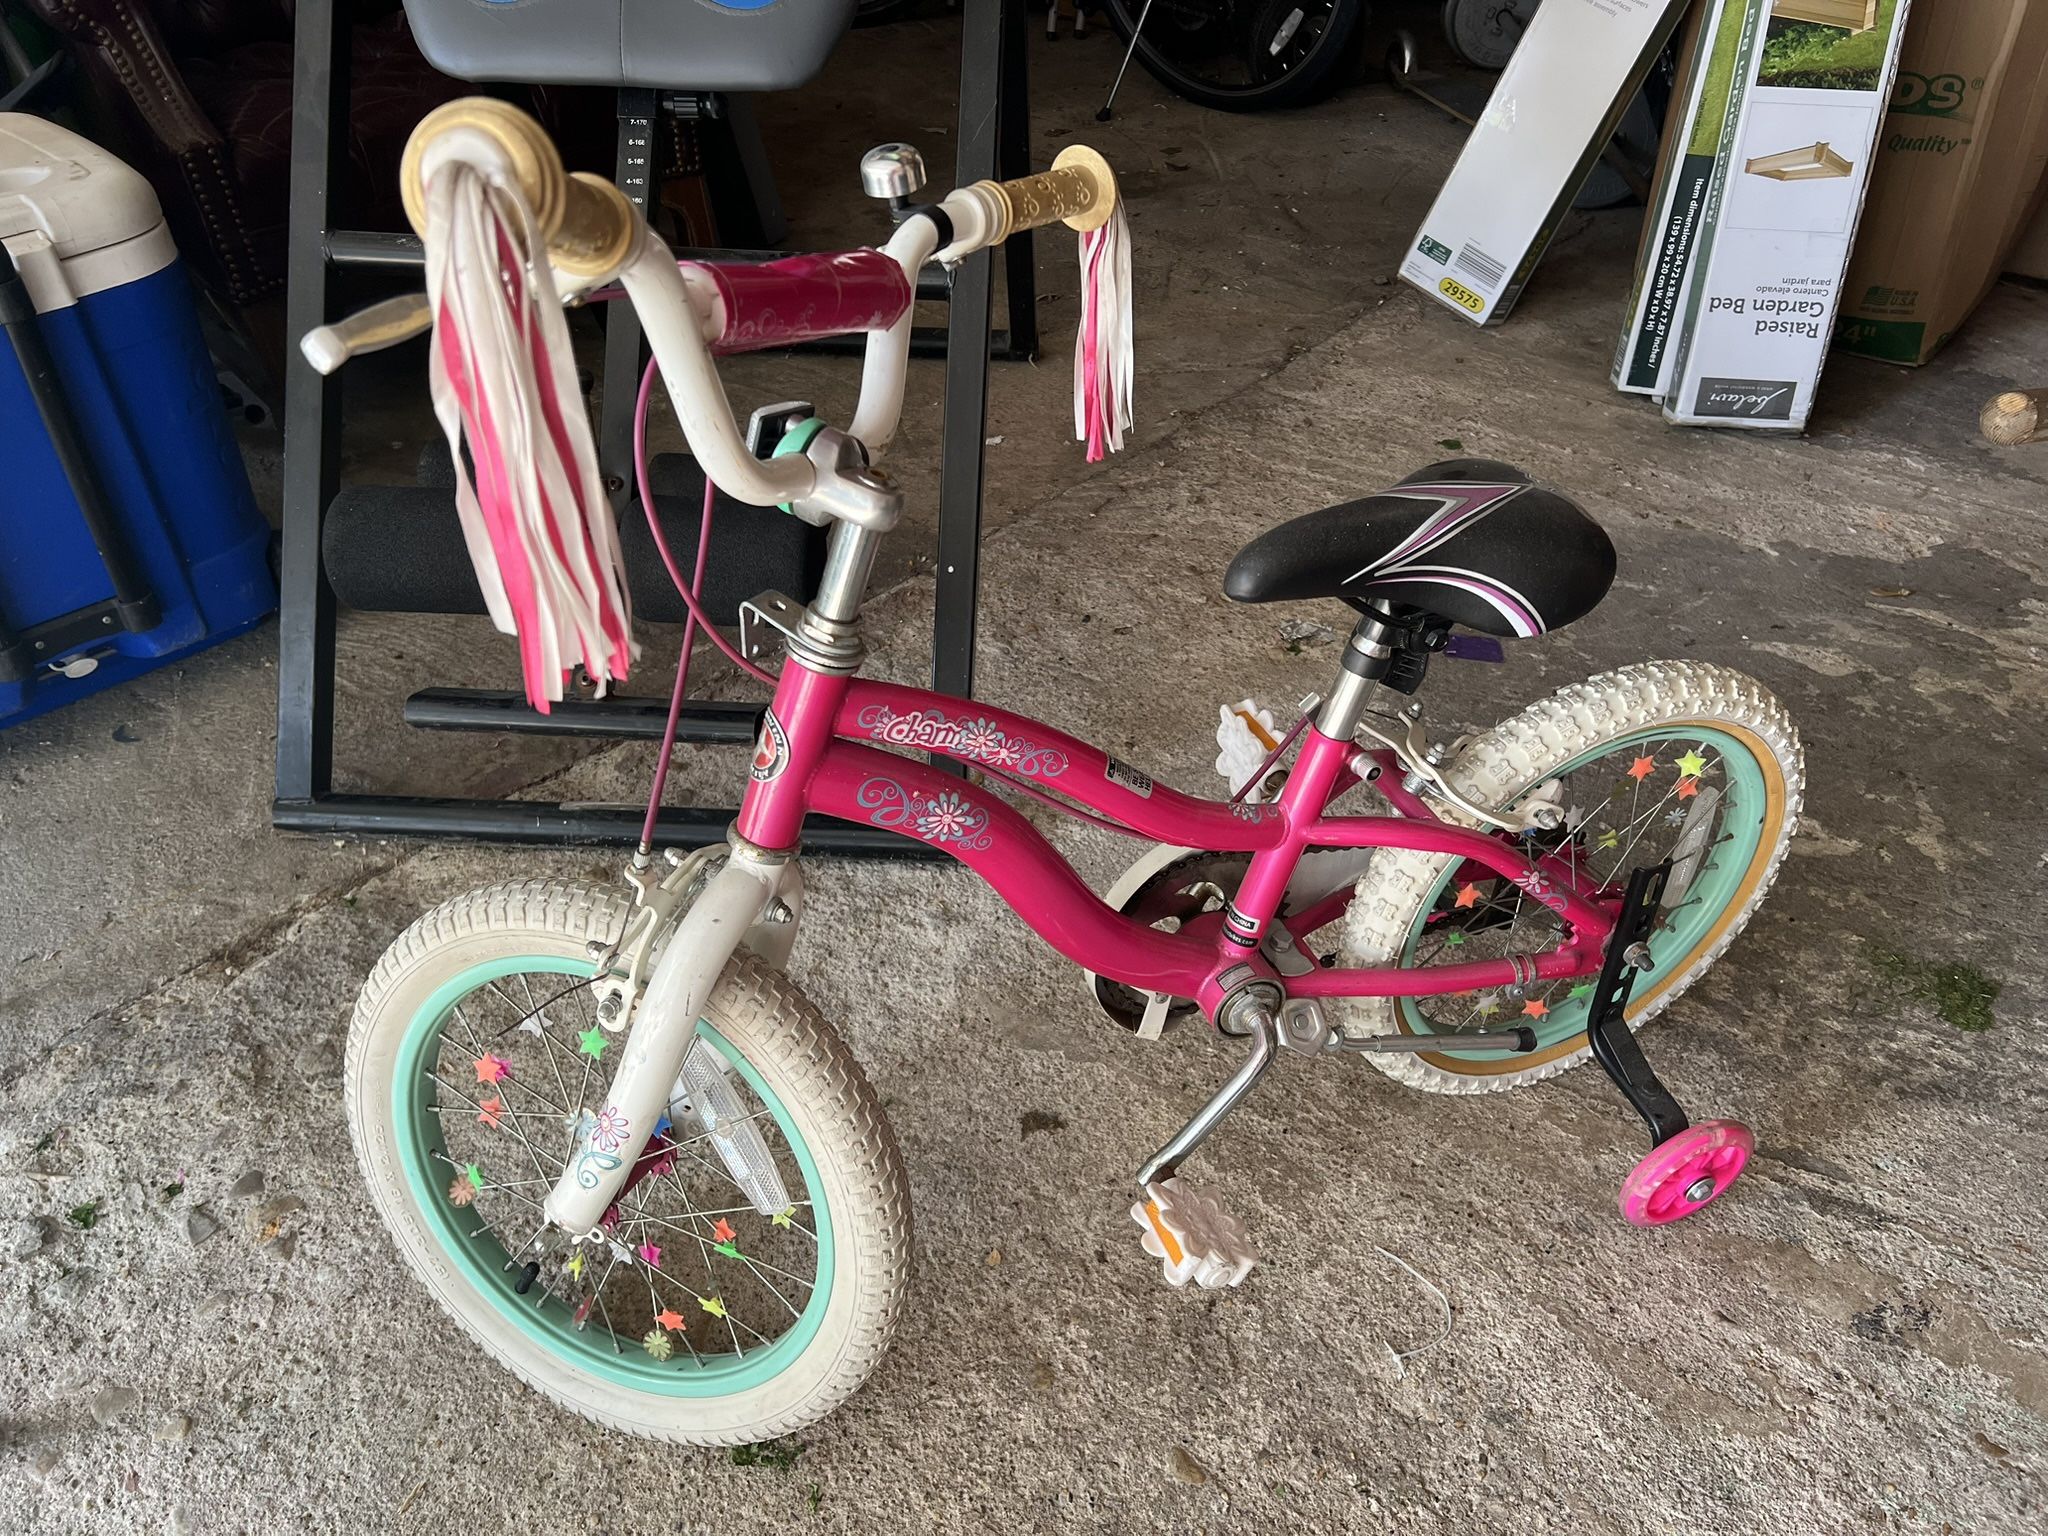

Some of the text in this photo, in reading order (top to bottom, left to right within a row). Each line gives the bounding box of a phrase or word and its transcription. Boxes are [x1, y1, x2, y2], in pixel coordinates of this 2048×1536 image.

[1741, 8, 1755, 53] Bed
[1889, 71, 1966, 112] DS
[1888, 134, 1958, 156] Quality
[1692, 178, 1705, 199] Item
[1671, 215, 1683, 236] (139
[1678, 200, 1698, 253] dimensions:
[1666, 244, 1675, 255] 99
[1660, 263, 1670, 274] 20
[1671, 254, 1684, 278] 54.72
[1657, 275, 1666, 288] cm
[1756, 285, 1829, 297] Cantero elevado
[1809, 278, 1832, 287] para
[1443, 281, 1480, 309] 29575
[1654, 289, 1664, 298] W
[1663, 286, 1676, 310] 38.97
[1650, 305, 1659, 313] D
[1709, 297, 1824, 318] Garden Bed
[1645, 321, 1655, 331] H)
[1754, 320, 1819, 339] Raised
[1707, 387, 1788, 414] belavi
